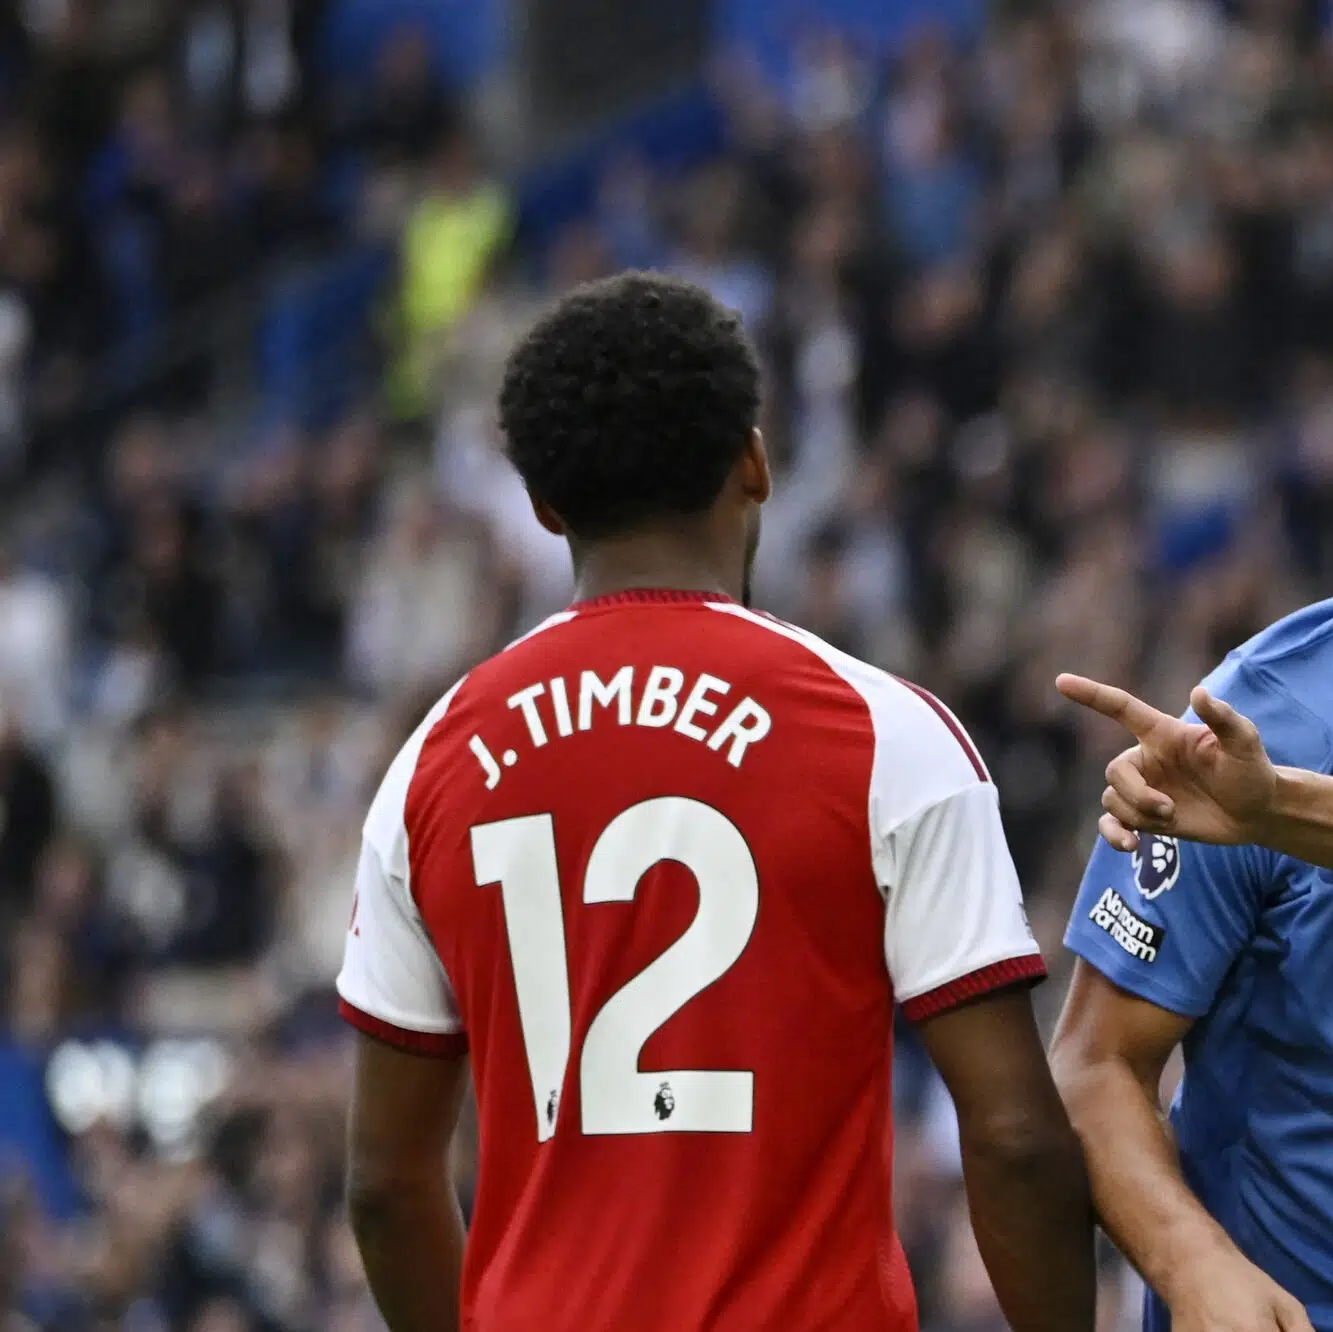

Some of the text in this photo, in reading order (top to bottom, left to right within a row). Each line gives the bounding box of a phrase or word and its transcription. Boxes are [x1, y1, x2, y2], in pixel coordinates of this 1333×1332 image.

[467, 665, 773, 790] J. TIMBER
[469, 795, 760, 1144] 12
[1098, 887, 1154, 944] No room
